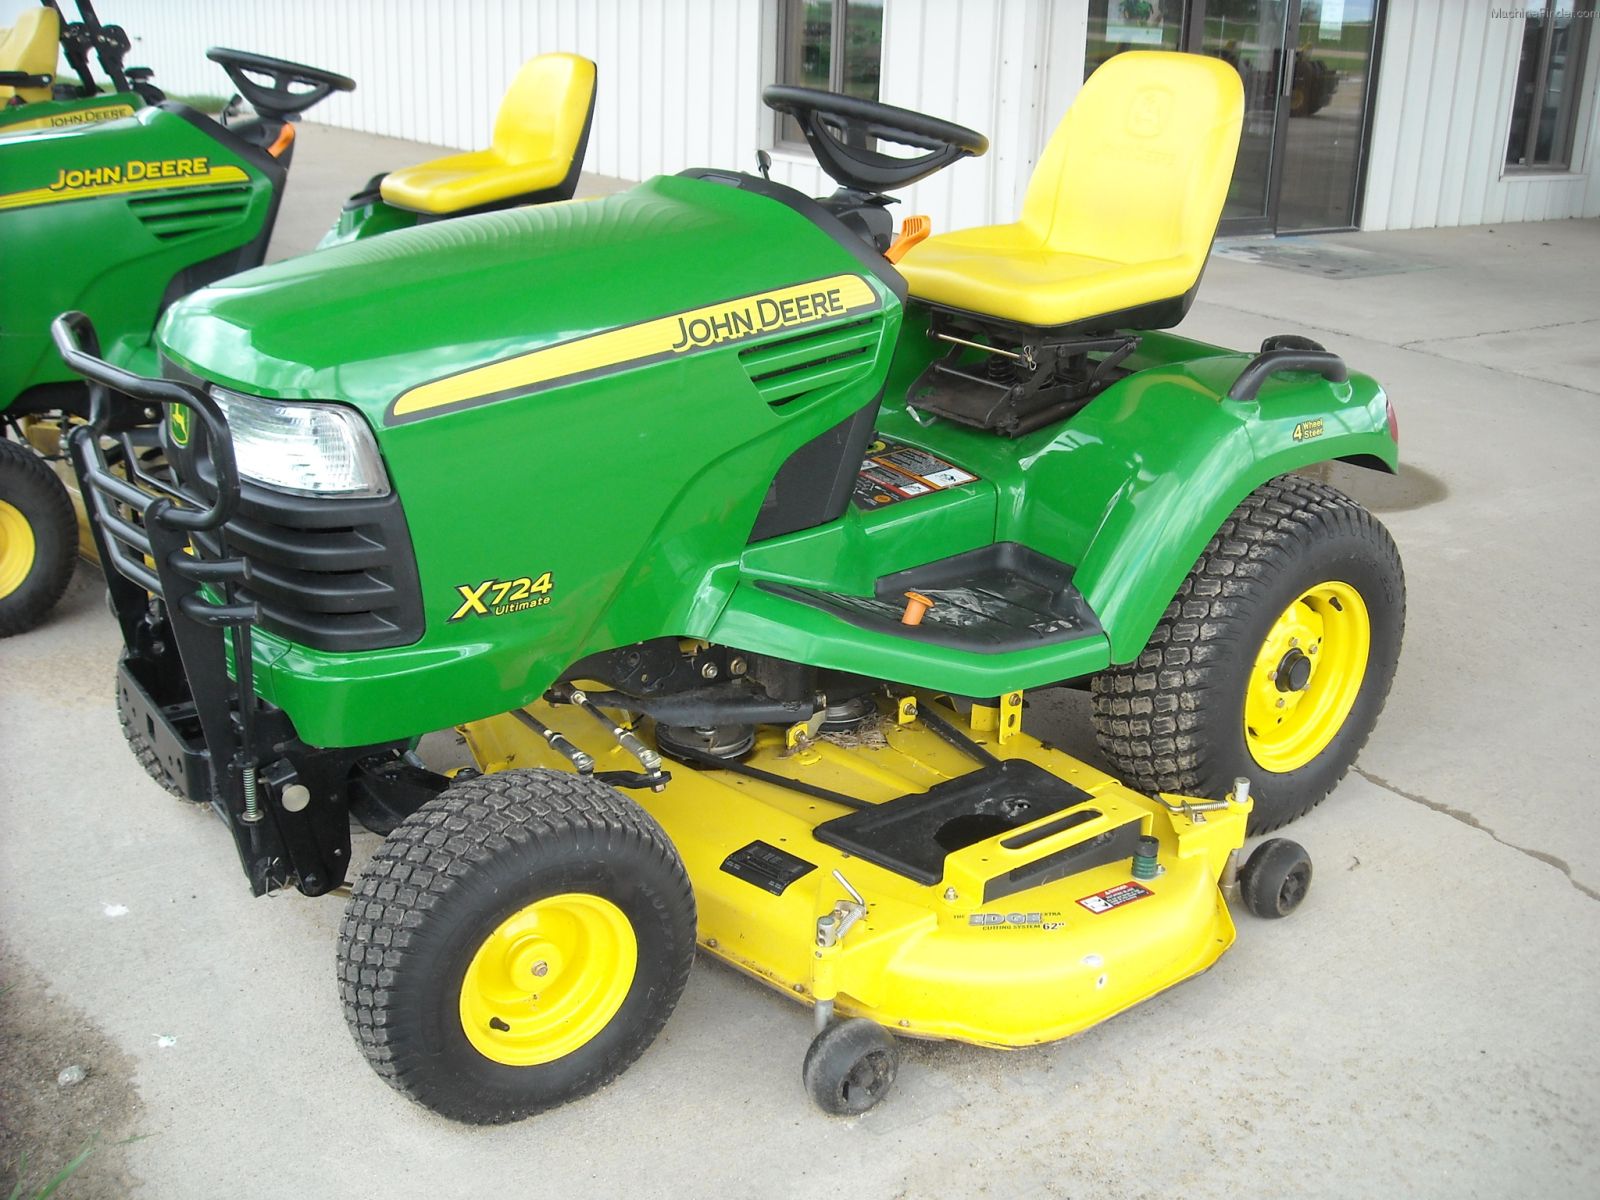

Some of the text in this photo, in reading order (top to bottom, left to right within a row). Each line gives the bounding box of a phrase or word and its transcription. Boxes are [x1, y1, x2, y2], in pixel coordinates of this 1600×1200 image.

[50, 107, 127, 128] JOHN DEERE
[50, 157, 211, 190] JOHN DEERE
[672, 288, 845, 349] JOHN DEERE
[1293, 417, 1323, 442] 4 Wheel
[1303, 428, 1324, 440] Steer
[446, 571, 553, 624] X724
[495, 595, 551, 616] Ultimate
[1042, 922, 1065, 931] 62"
